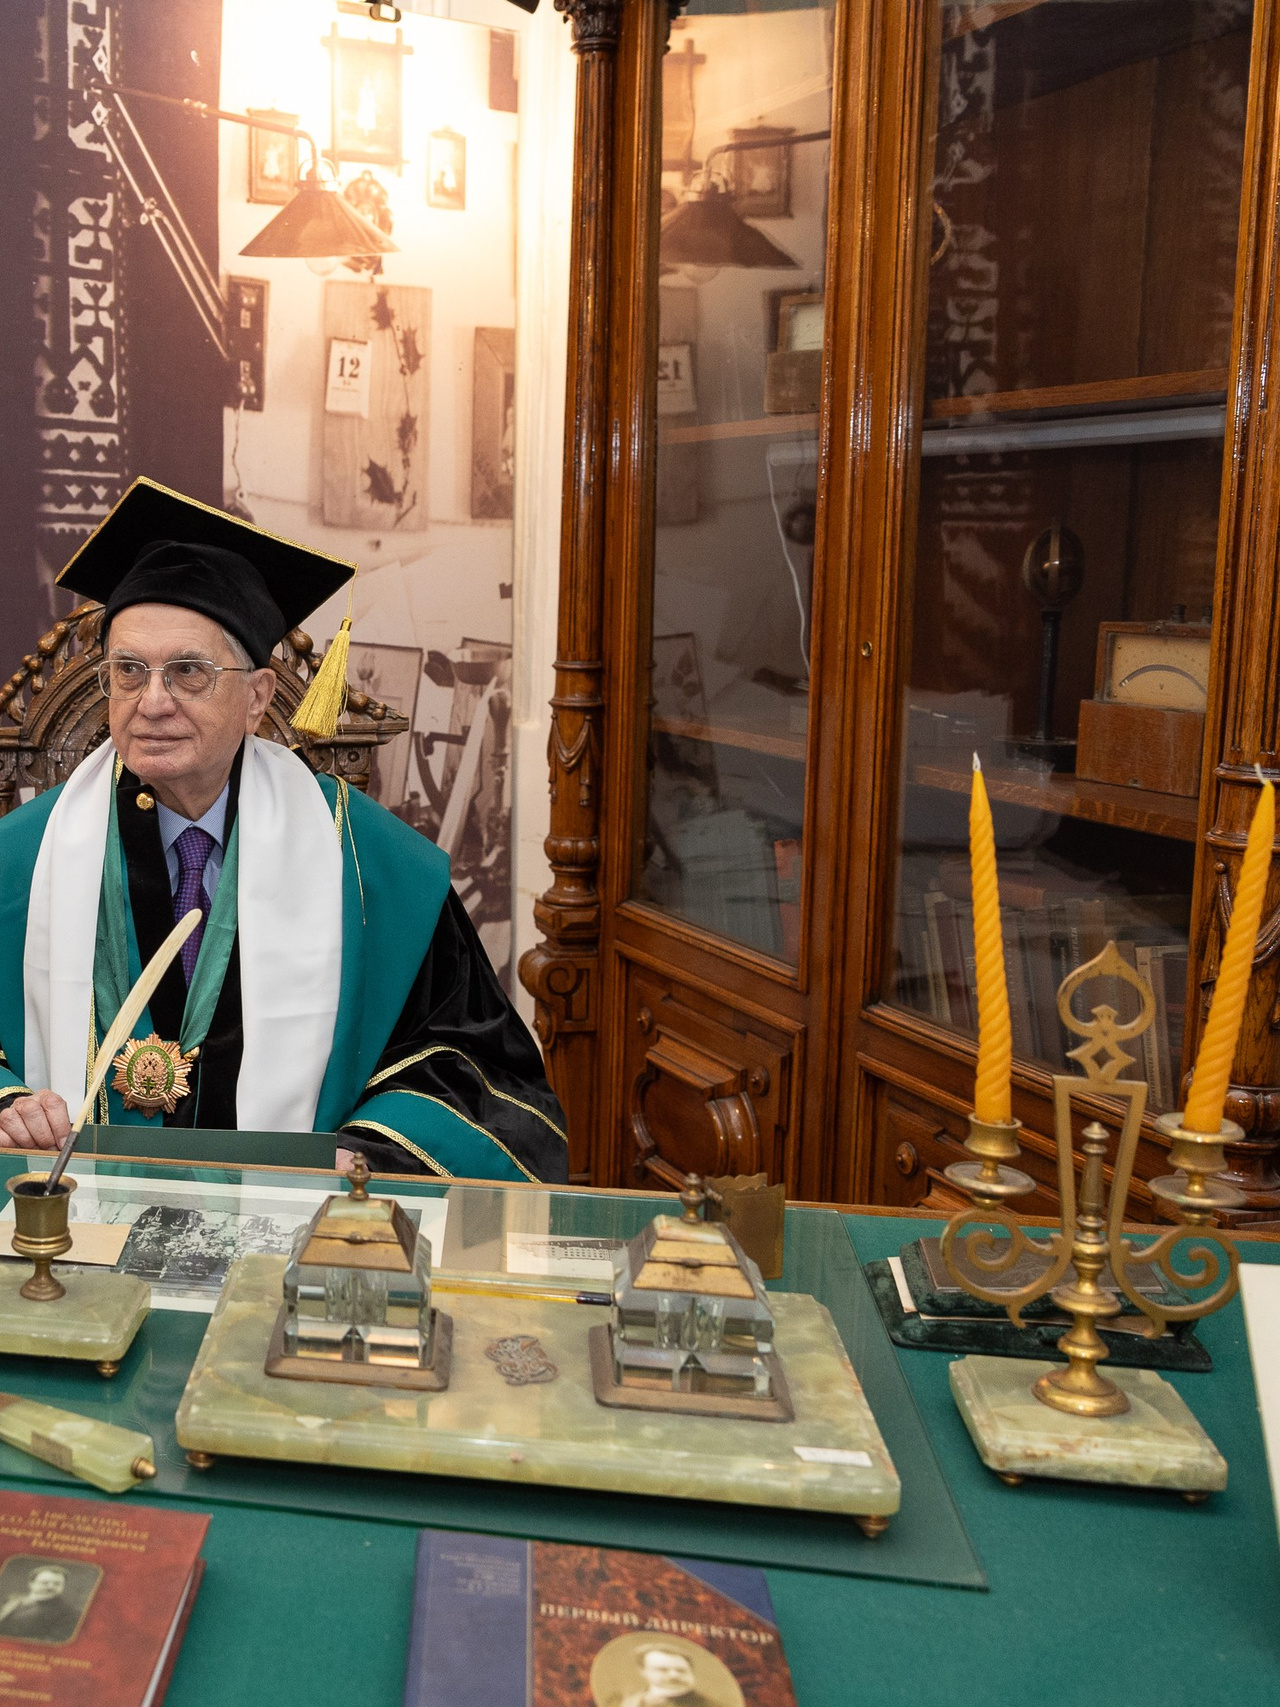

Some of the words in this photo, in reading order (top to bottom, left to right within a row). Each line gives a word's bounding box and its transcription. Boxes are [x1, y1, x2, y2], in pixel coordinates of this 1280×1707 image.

[339, 356, 360, 379] 12
[540, 1603, 640, 1627] ПЕРВЫЙ
[645, 1616, 775, 1645] ДИРЕКТОР
